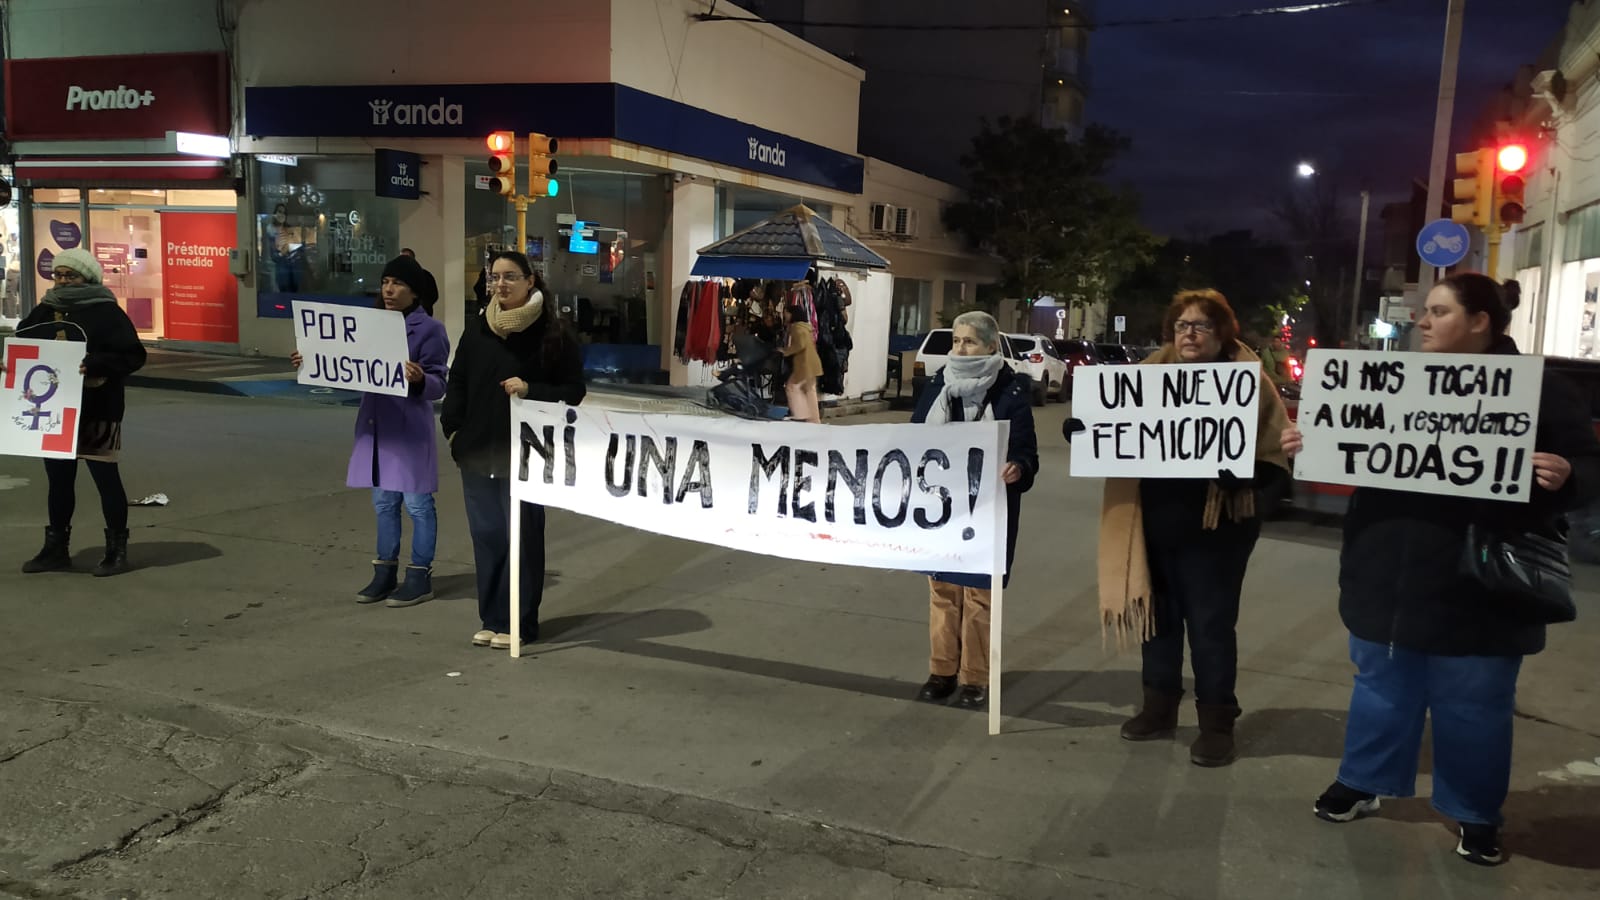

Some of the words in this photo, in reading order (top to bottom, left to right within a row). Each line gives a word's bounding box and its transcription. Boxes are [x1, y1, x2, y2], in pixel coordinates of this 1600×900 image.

[66, 85, 155, 111] Pronto+
[393, 97, 463, 125] anda
[758, 142, 786, 167] anda
[390, 175, 415, 187] anda
[167, 257, 174, 266] a
[176, 256, 214, 268] medida
[301, 309, 357, 343] POR
[309, 353, 405, 389] JUSTICIA
[1099, 369, 1143, 409] UN
[1162, 368, 1256, 408] NUEVO
[1321, 359, 1349, 391] SI
[1360, 361, 1405, 395] NOS
[1425, 364, 1513, 397] TOCAN
[1092, 416, 1246, 463] FEMICIDIO
[1314, 403, 1334, 428] A
[1341, 402, 1395, 434] UNA,
[1403, 399, 1531, 444] respondemos
[1337, 441, 1526, 495] TODAS!!
[605, 433, 714, 508] UNA
[748, 443, 985, 541] MENOS!
